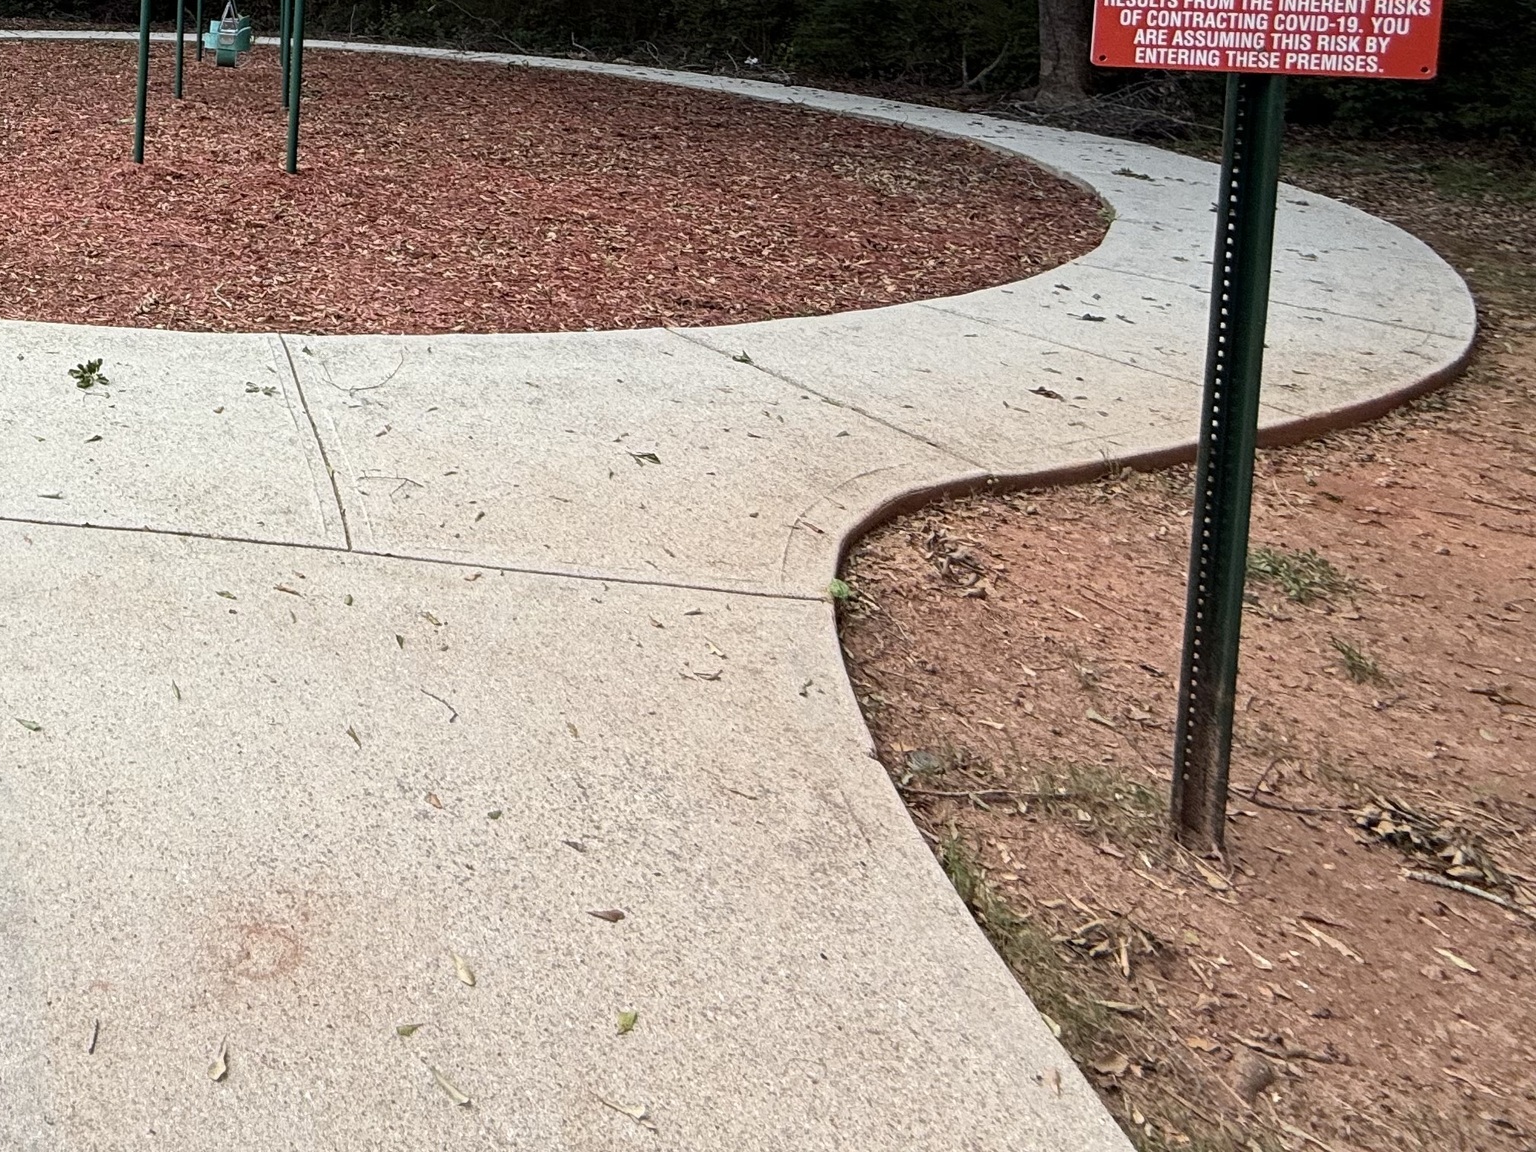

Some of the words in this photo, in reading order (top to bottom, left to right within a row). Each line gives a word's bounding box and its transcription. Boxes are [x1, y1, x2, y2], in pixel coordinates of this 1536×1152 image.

[1120, 9, 1142, 26] OF
[1147, 10, 1268, 30] CONTRACTING
[1274, 14, 1363, 33] COVID-19.
[1371, 17, 1410, 35] YOU
[1134, 29, 1168, 45] ARE
[1172, 30, 1265, 49] ASSUMING
[1271, 33, 1312, 50] THIS
[1317, 35, 1360, 52] RISK
[1365, 36, 1390, 53] BY
[1135, 47, 1220, 66] ENTERING
[1226, 50, 1280, 69] THESE
[1285, 53, 1384, 73] PREMISES.
